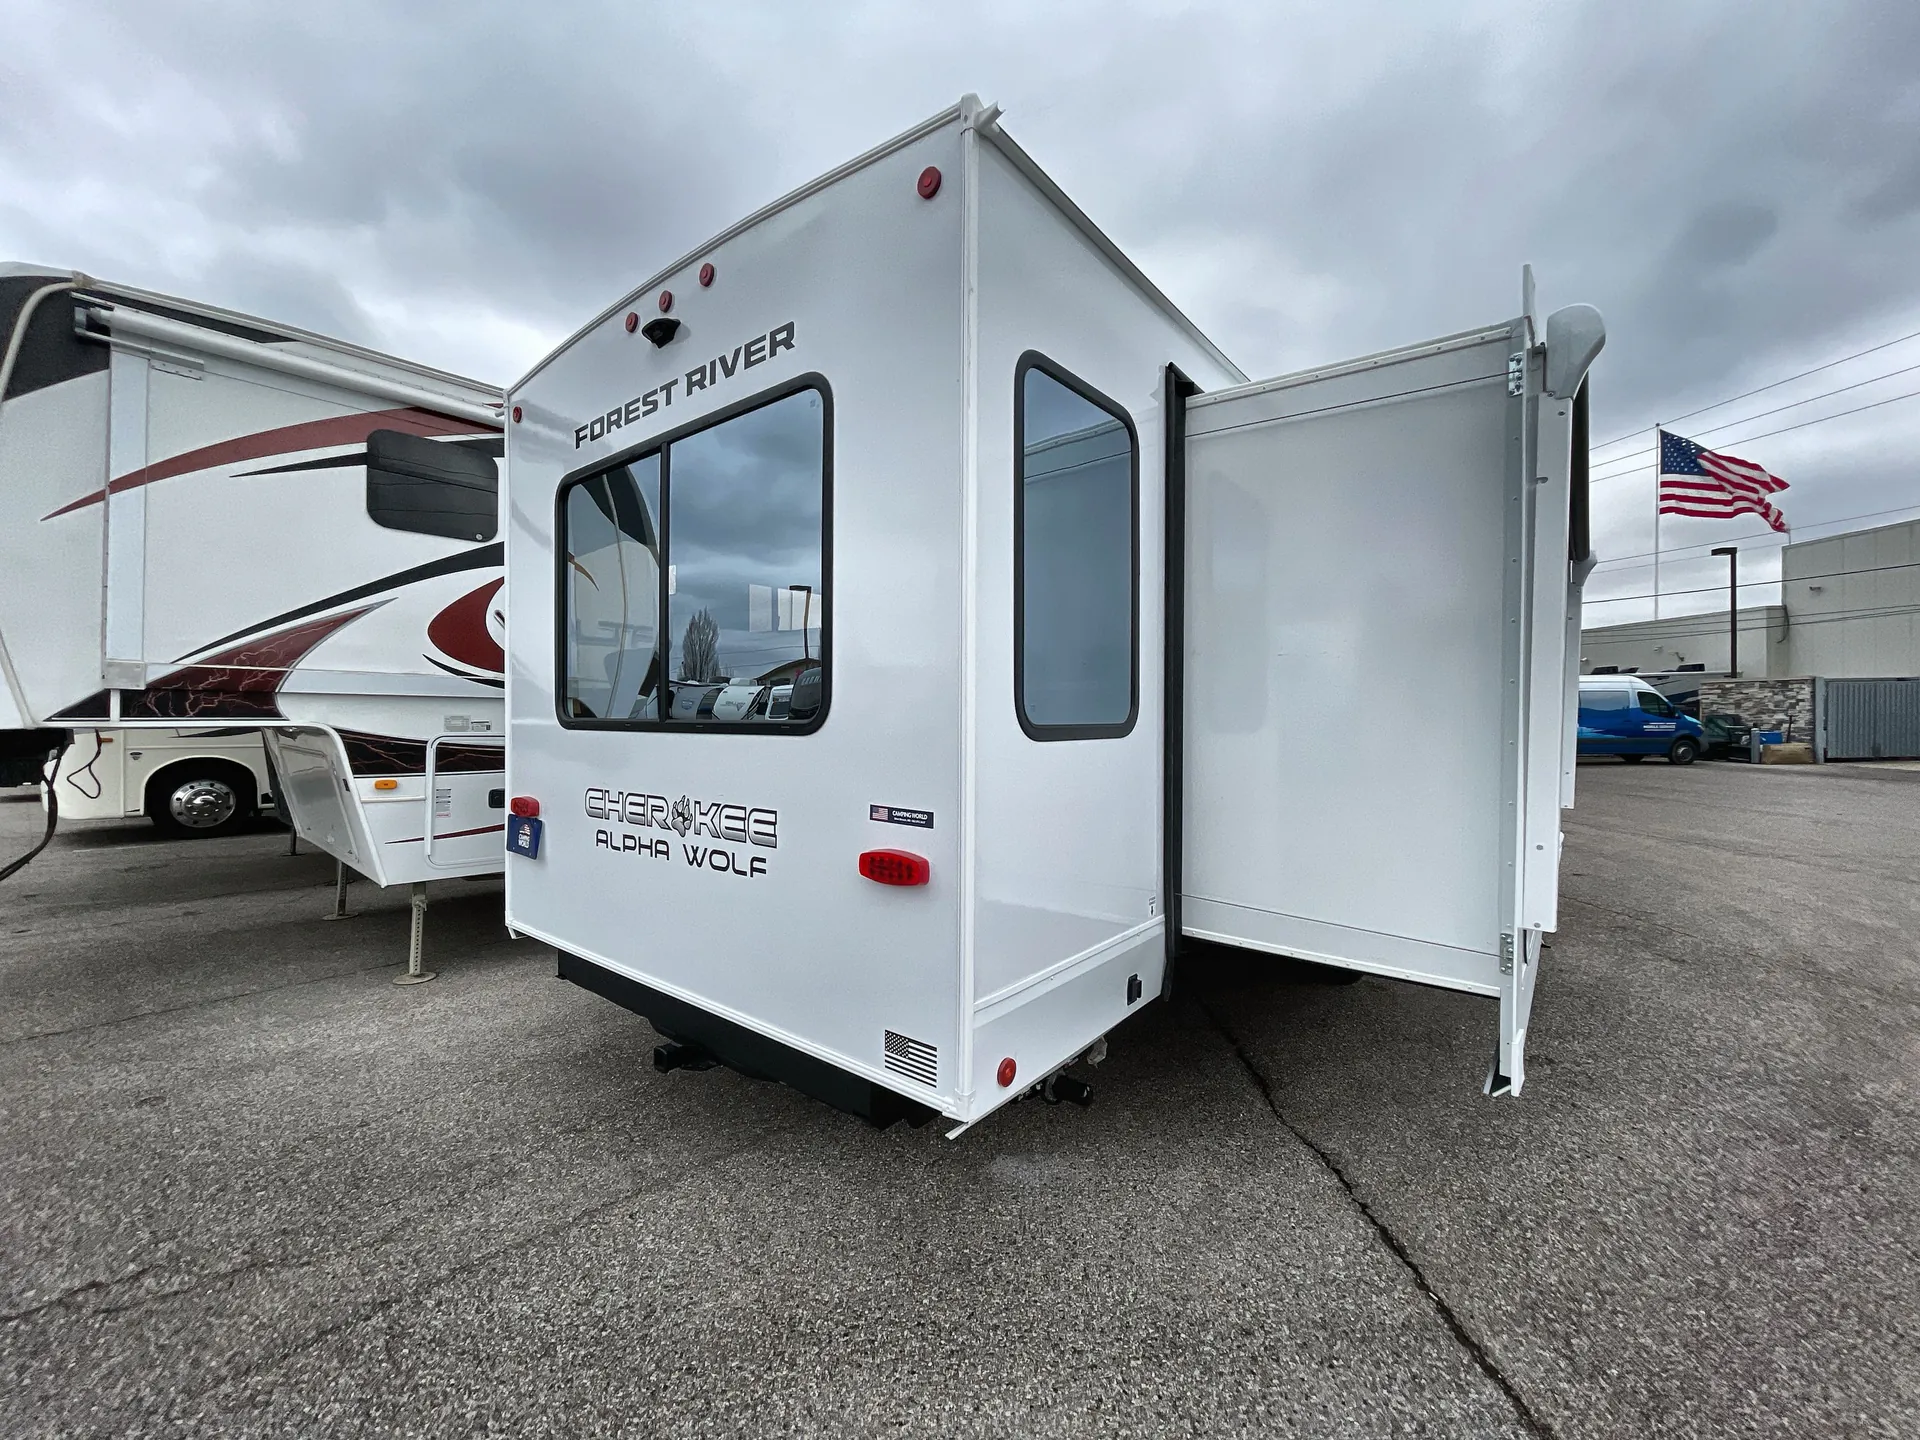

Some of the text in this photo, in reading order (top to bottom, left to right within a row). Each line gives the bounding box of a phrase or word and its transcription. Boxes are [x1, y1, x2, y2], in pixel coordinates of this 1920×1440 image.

[574, 320, 796, 450] FOREST RIVER
[912, 812, 928, 820] WORLD
[595, 829, 767, 878] ALPHA WOLF
